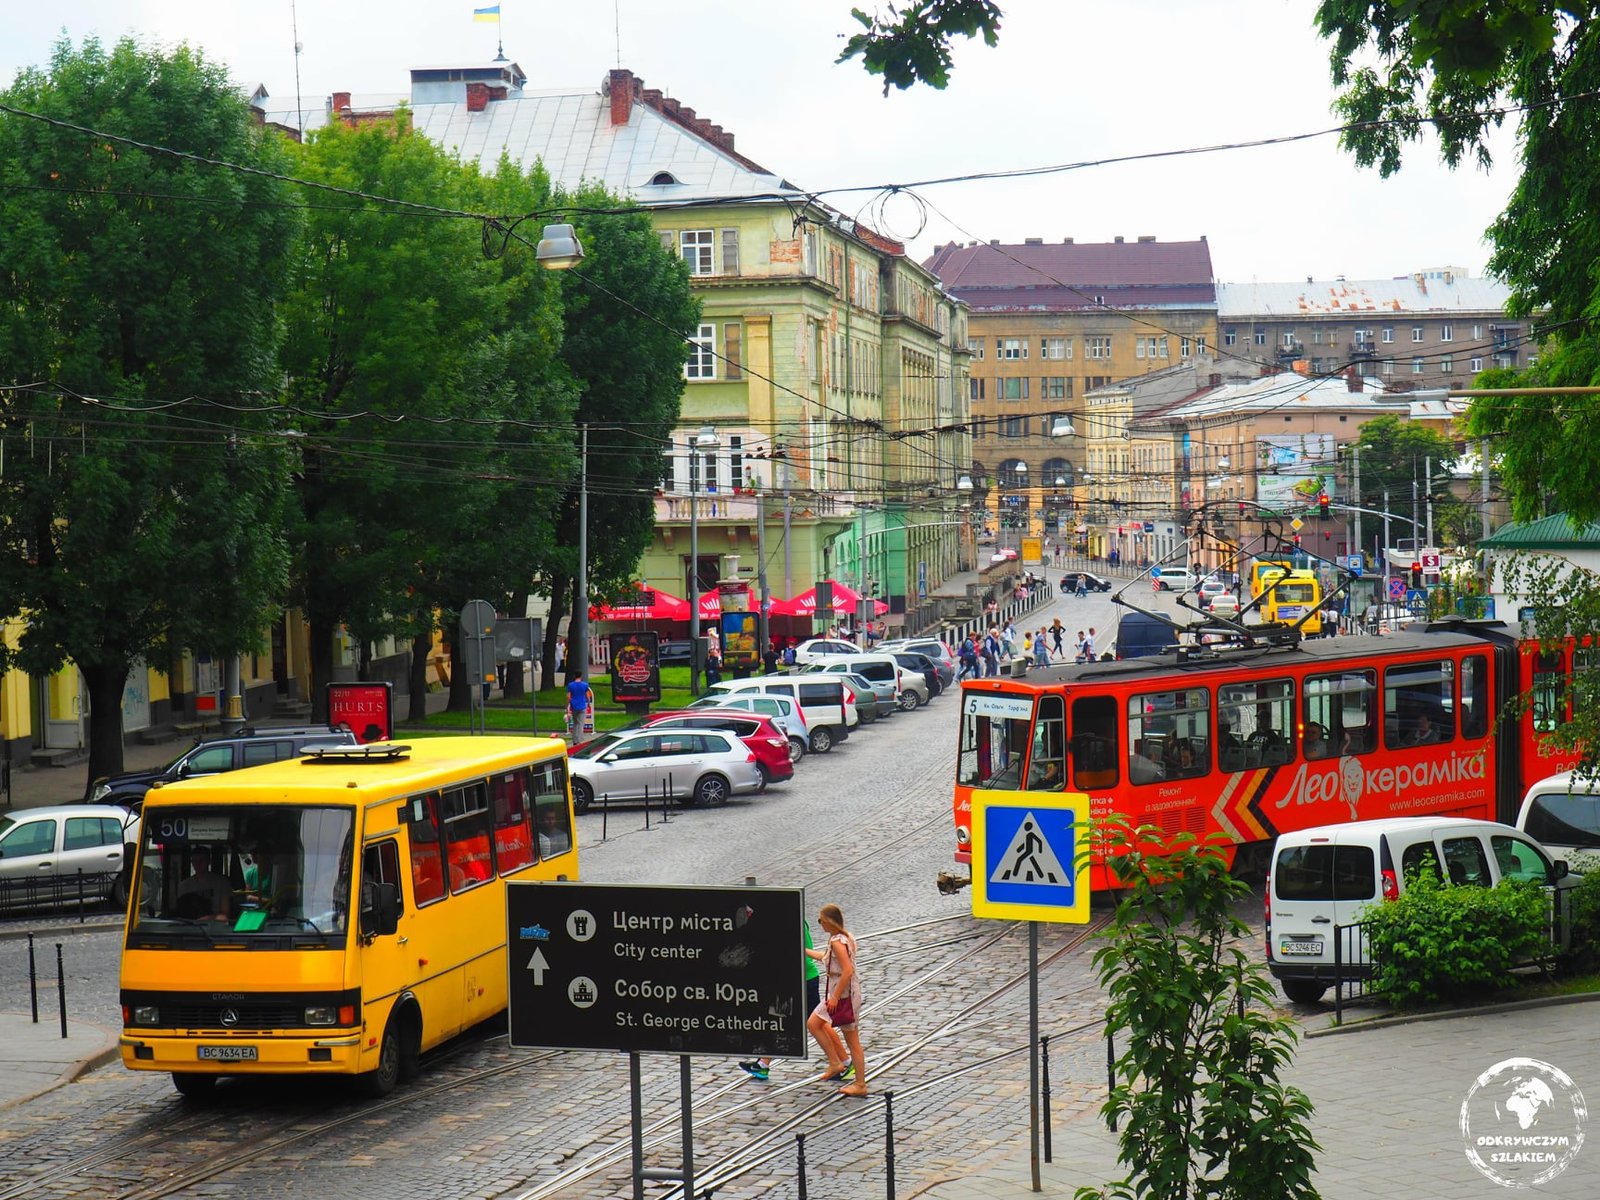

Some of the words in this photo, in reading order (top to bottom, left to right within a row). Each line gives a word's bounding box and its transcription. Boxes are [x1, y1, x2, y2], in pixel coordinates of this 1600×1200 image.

[334, 702, 384, 712] HURTS
[969, 699, 977, 713] 5
[1275, 763, 1338, 809] Лео
[1366, 751, 1485, 797] кераміка
[1389, 788, 1485, 812] www.leoceramika.com
[161, 817, 186, 837] 50
[613, 911, 674, 934] Центр
[680, 913, 734, 932] міста
[613, 942, 646, 961] City
[651, 944, 703, 959] center
[614, 979, 678, 1003] Собор
[683, 985, 710, 1000] св.
[715, 983, 759, 1006] Юра
[616, 1011, 638, 1027] St.
[642, 1012, 700, 1031] George
[704, 1014, 785, 1032] Cathedral
[204, 1047, 217, 1058] BC
[219, 1047, 240, 1058] 9634
[241, 1047, 255, 1058] EA
